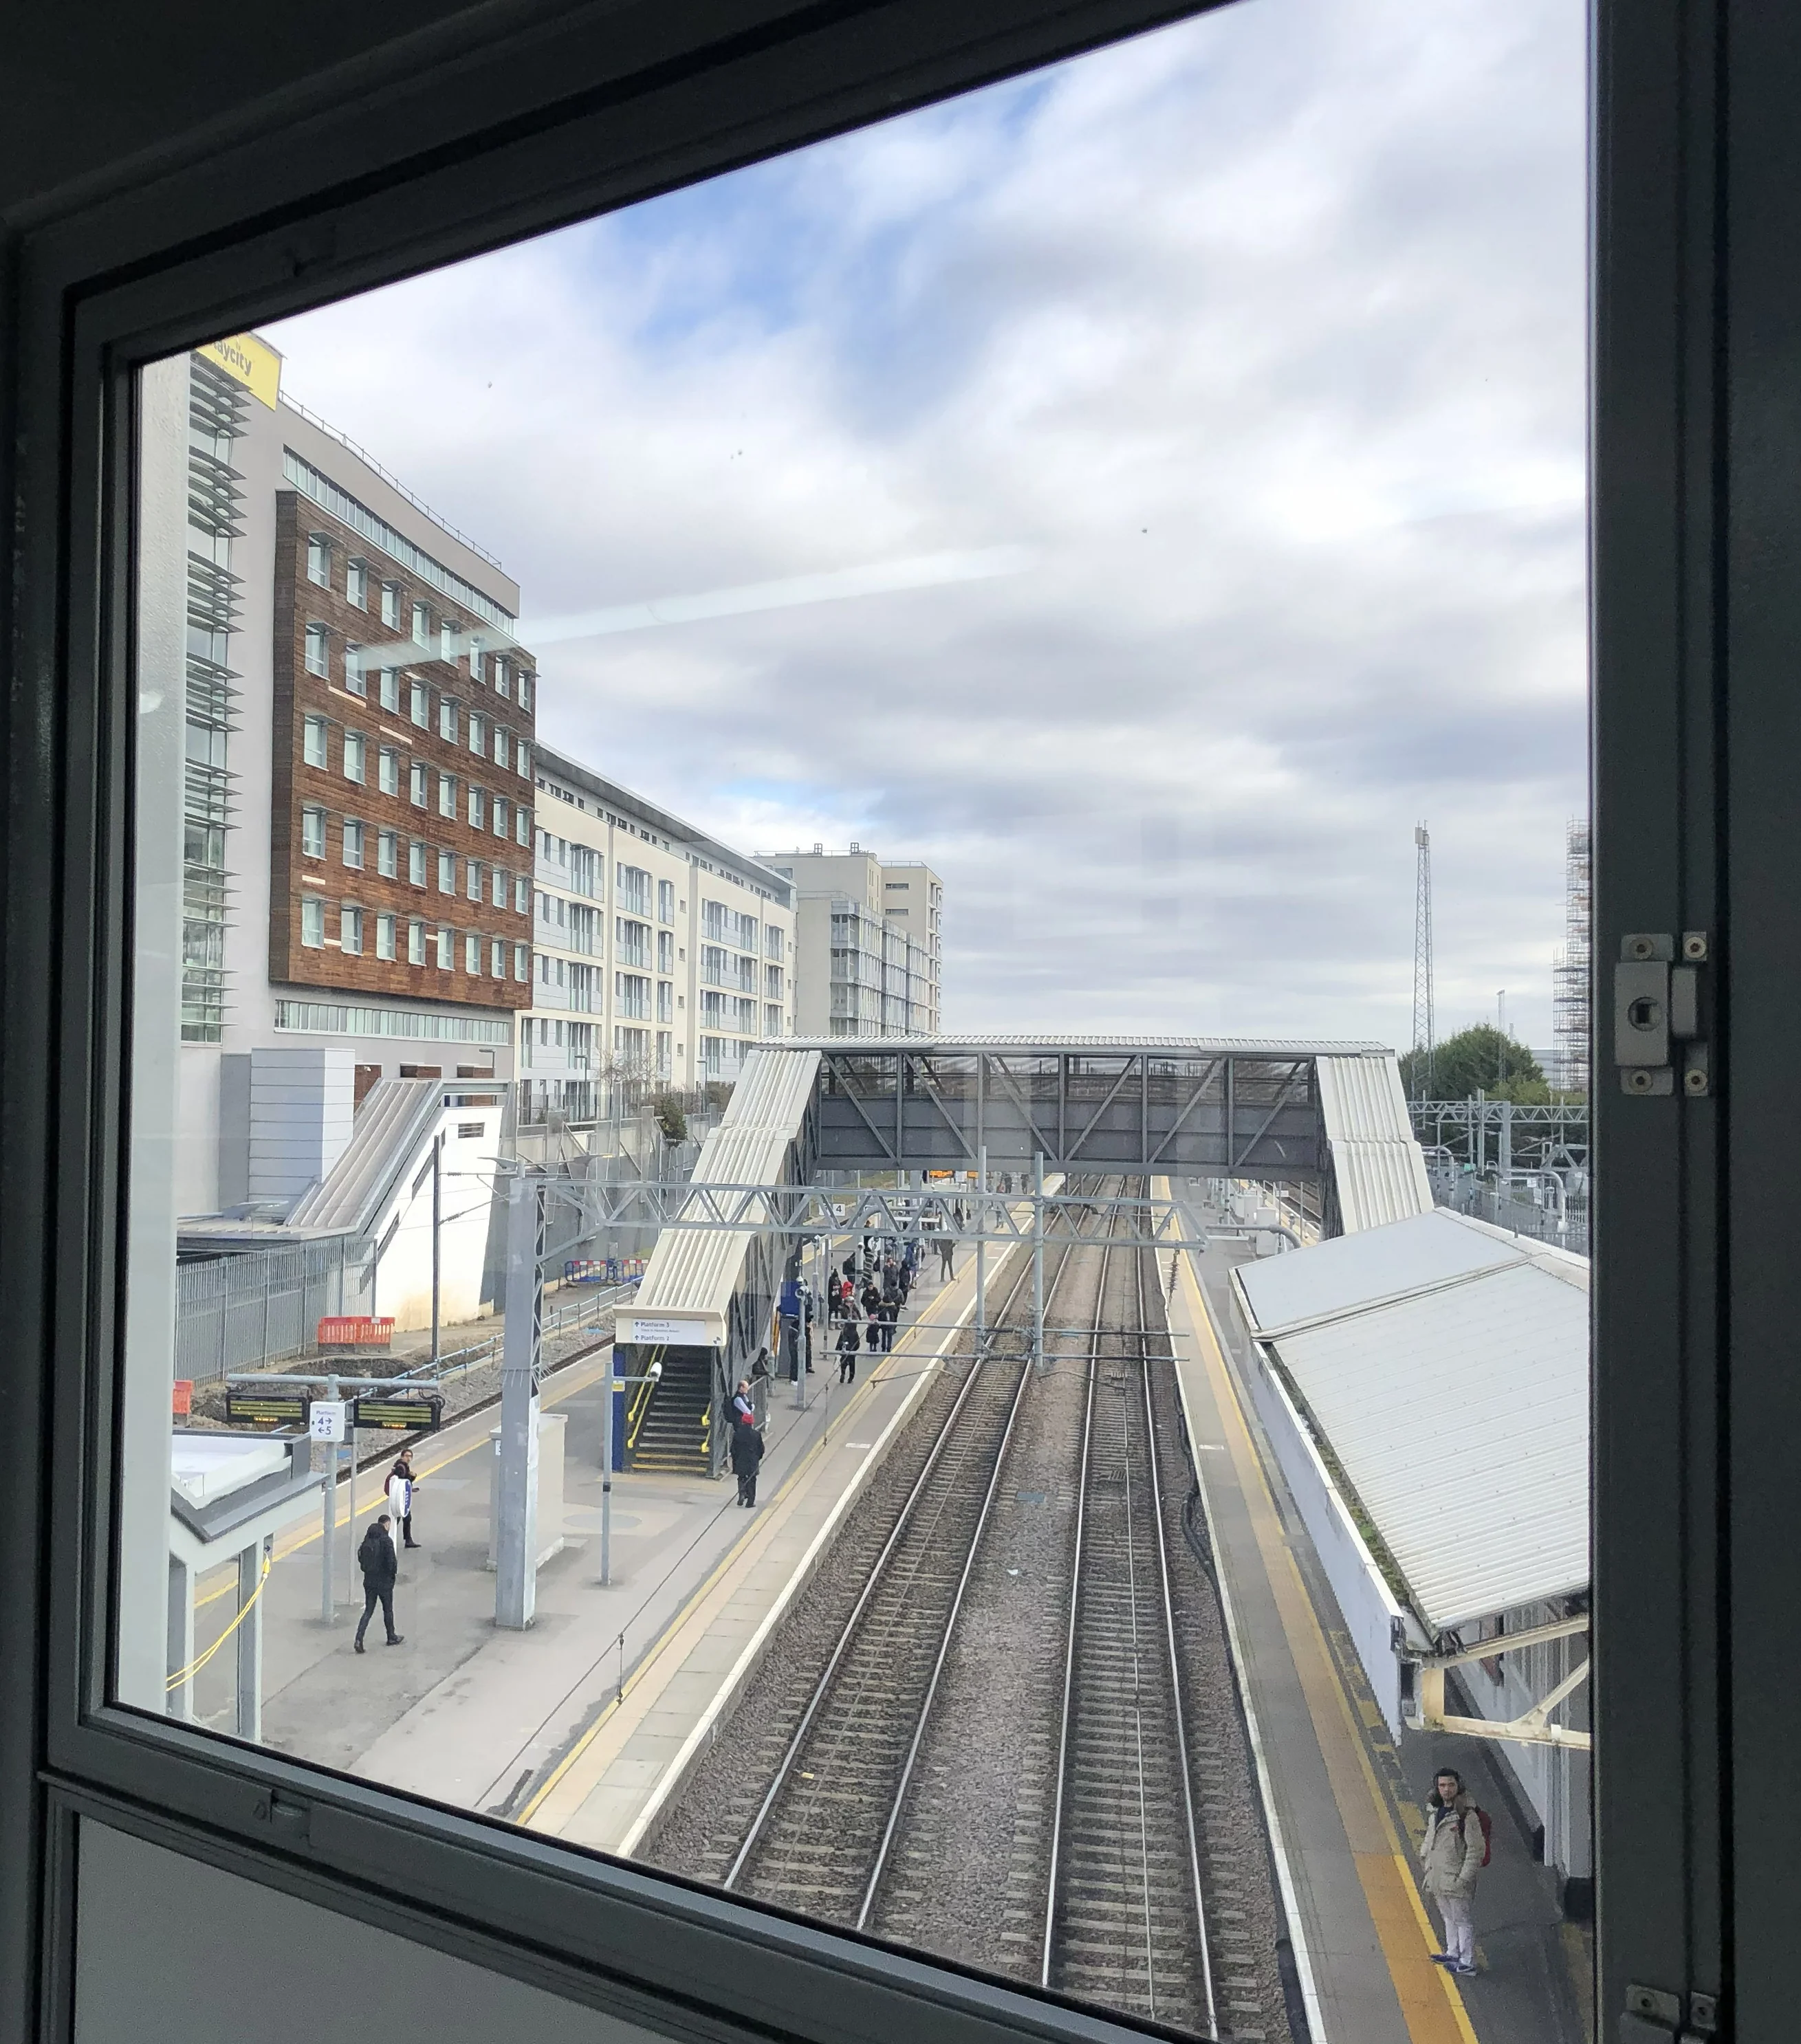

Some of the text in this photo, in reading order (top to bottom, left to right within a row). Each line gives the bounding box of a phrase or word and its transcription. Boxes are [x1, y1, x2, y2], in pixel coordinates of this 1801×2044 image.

[836, 1205, 842, 1213] 4
[318, 1416, 324, 1425] 4
[325, 1426, 331, 1435] 5
